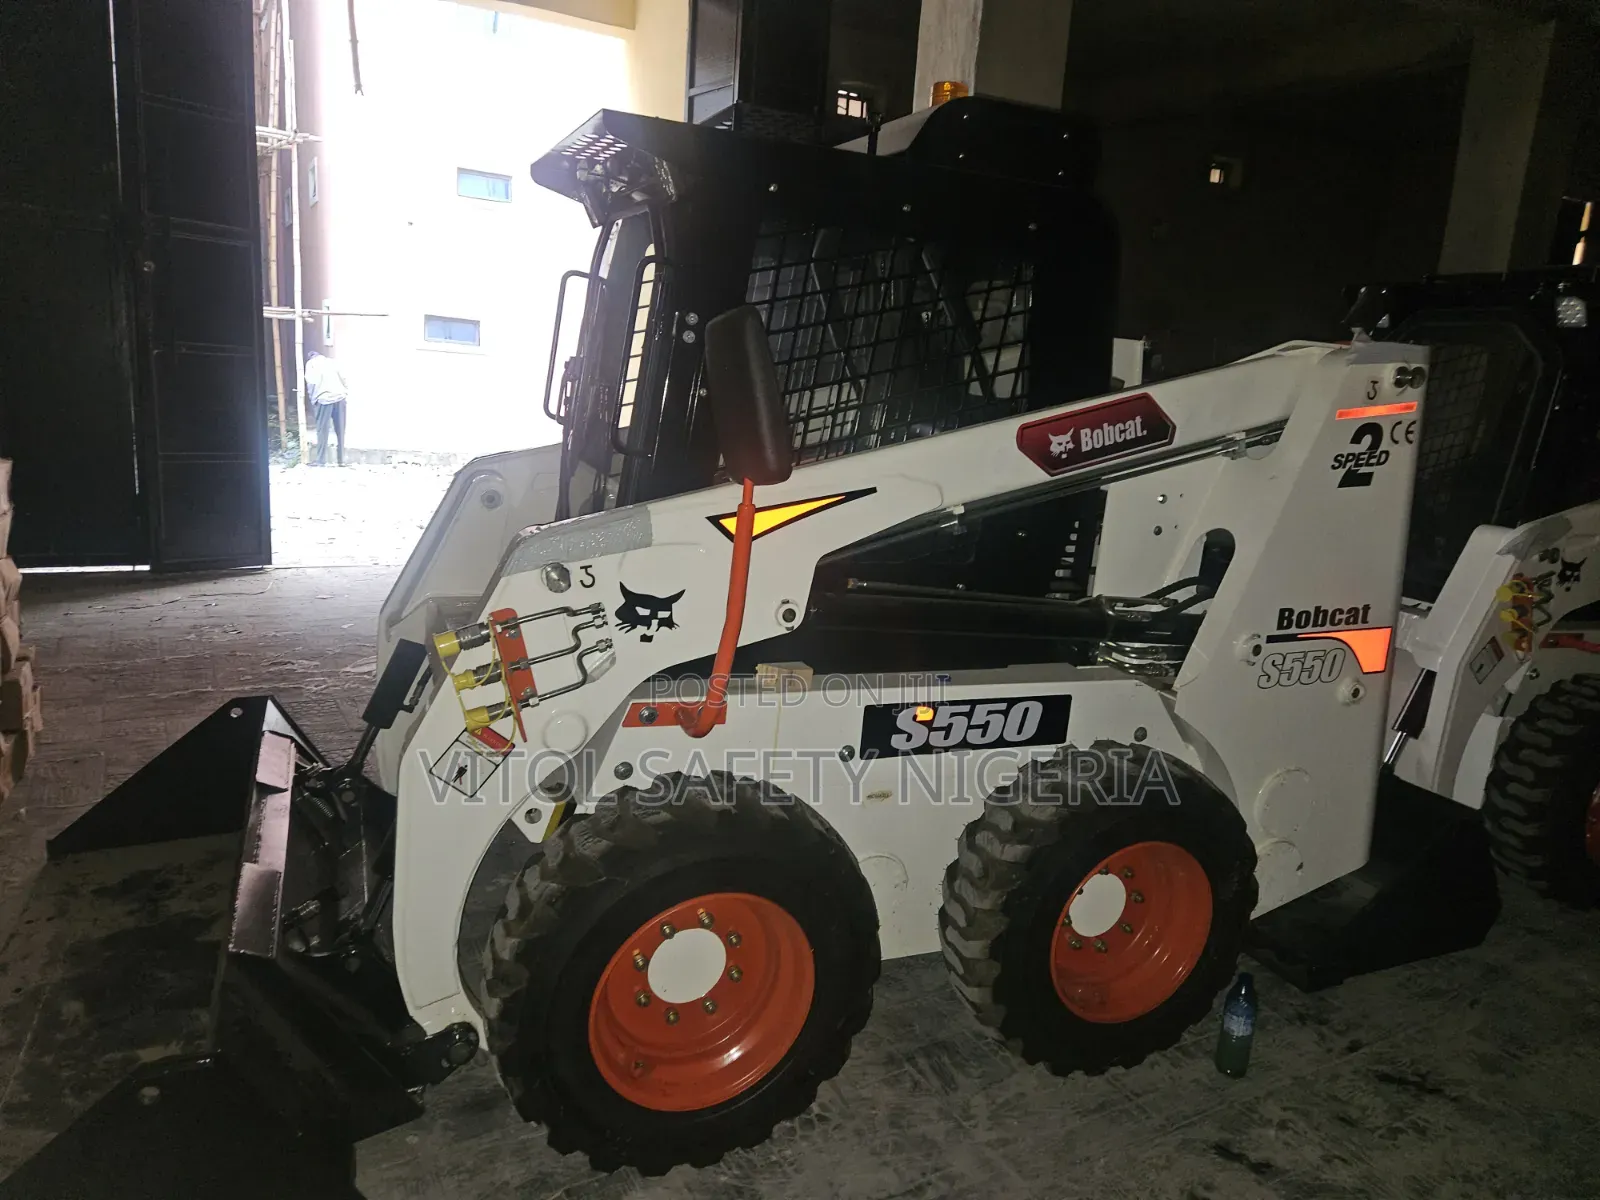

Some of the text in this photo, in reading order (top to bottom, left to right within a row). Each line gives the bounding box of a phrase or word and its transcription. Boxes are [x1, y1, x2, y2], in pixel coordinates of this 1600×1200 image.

[1390, 420, 1417, 444] CE
[1330, 450, 1390, 470] SPEED
[1337, 422, 1384, 488] 2
[1276, 604, 1371, 630] Bobcat
[1257, 648, 1346, 690] S550
[890, 700, 1044, 751] S550
